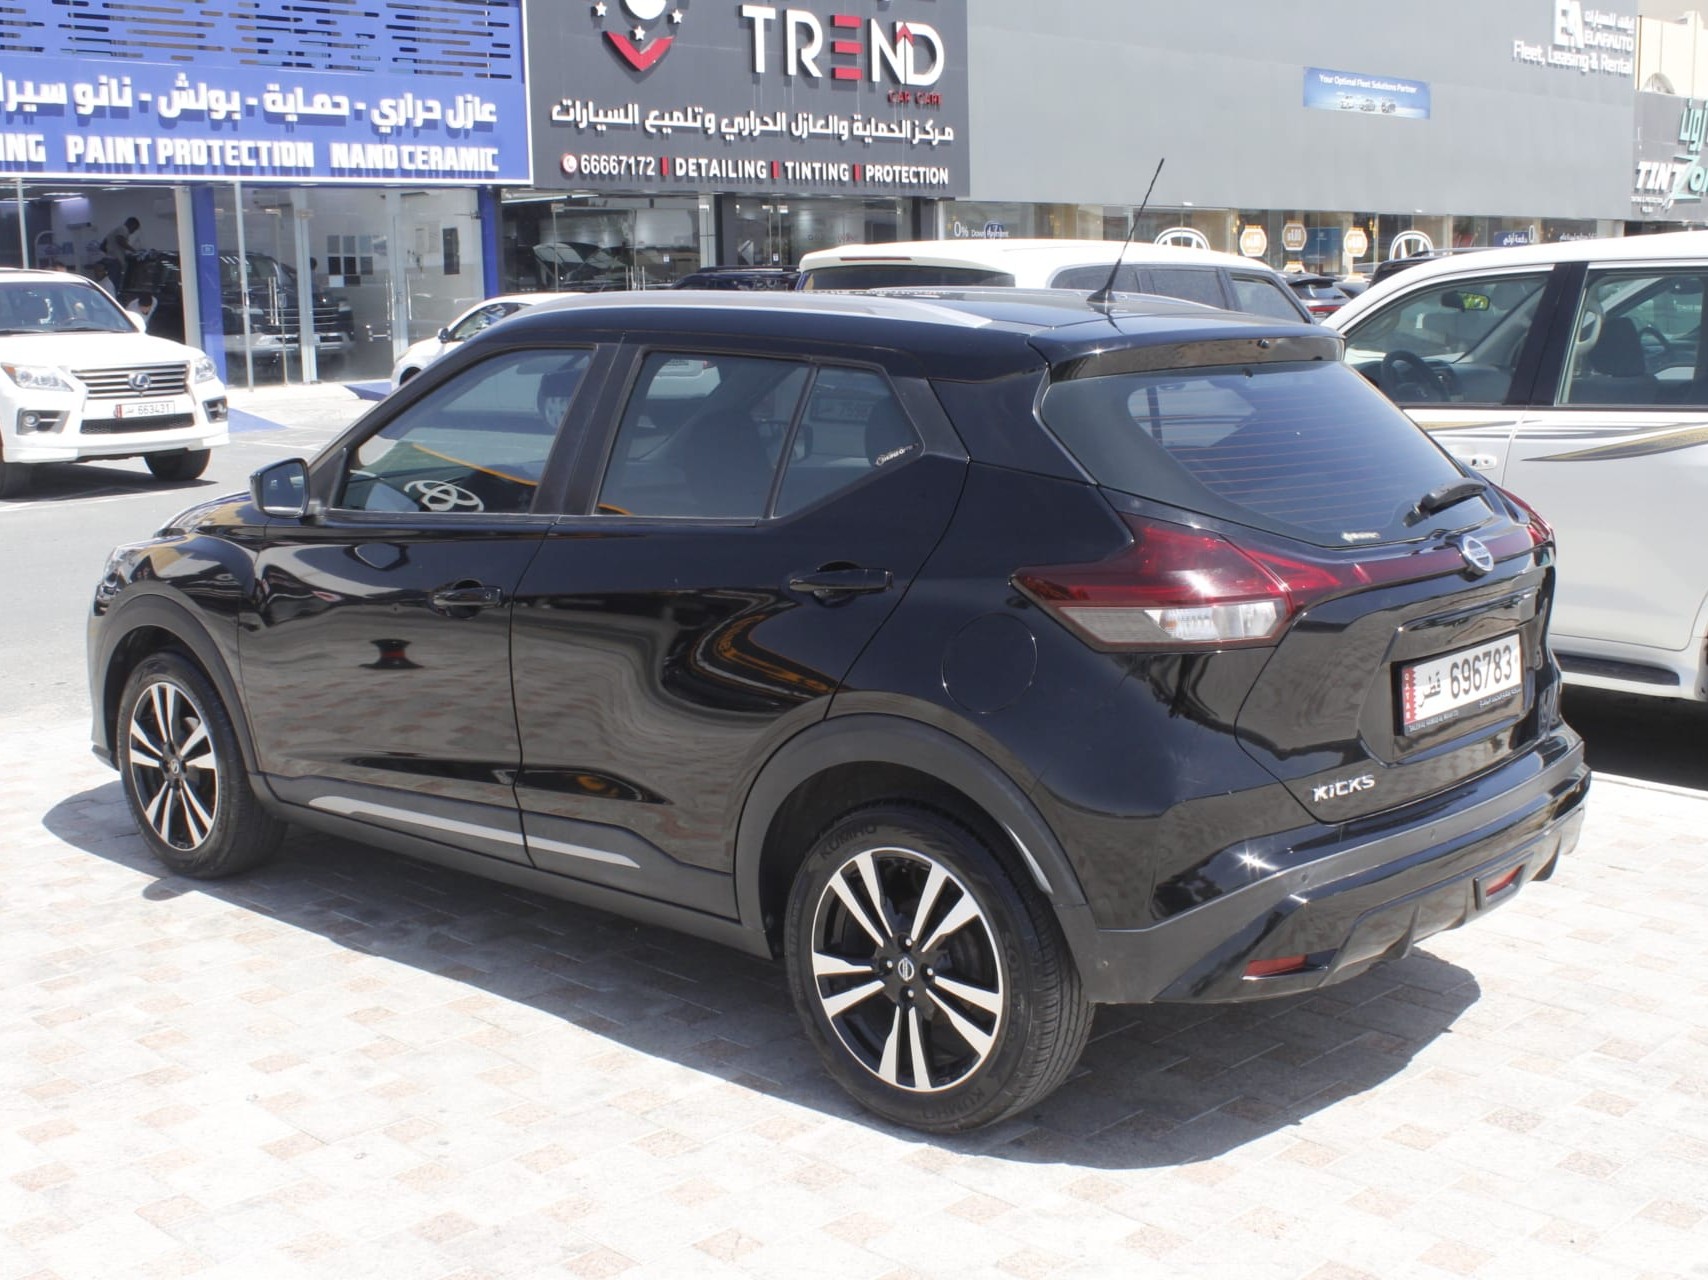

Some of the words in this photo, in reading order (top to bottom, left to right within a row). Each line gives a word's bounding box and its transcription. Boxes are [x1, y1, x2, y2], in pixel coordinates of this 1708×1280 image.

[738, 4, 945, 87] TREND
[1513, 40, 1545, 65] Fleet,
[1548, 45, 1589, 72] Leasing
[1601, 54, 1634, 74] Rental
[73, 75, 133, 116] نانو
[157, 71, 242, 121] بولش
[1318, 73, 1334, 84] Your
[262, 82, 350, 122] حماية
[370, 92, 442, 134] حراري
[445, 93, 498, 129] عازل
[551, 98, 640, 131] السيارات
[644, 105, 716, 135] وتلميع
[720, 109, 787, 141] الحراري
[790, 112, 850, 142] والعازل
[852, 114, 912, 144] الحماية
[912, 118, 954, 146] مركز
[65, 133, 152, 165] PAINT
[156, 137, 315, 168] PROTECTION
[329, 141, 399, 170] NANO
[400, 145, 499, 172] CERAMIC
[580, 154, 656, 177] 66667172
[674, 157, 768, 179] DETAILING
[784, 161, 850, 182] TINTING
[865, 164, 949, 185] PROTECTION
[1418, 671, 1441, 708] قطر
[1450, 644, 1512, 700] 696783
